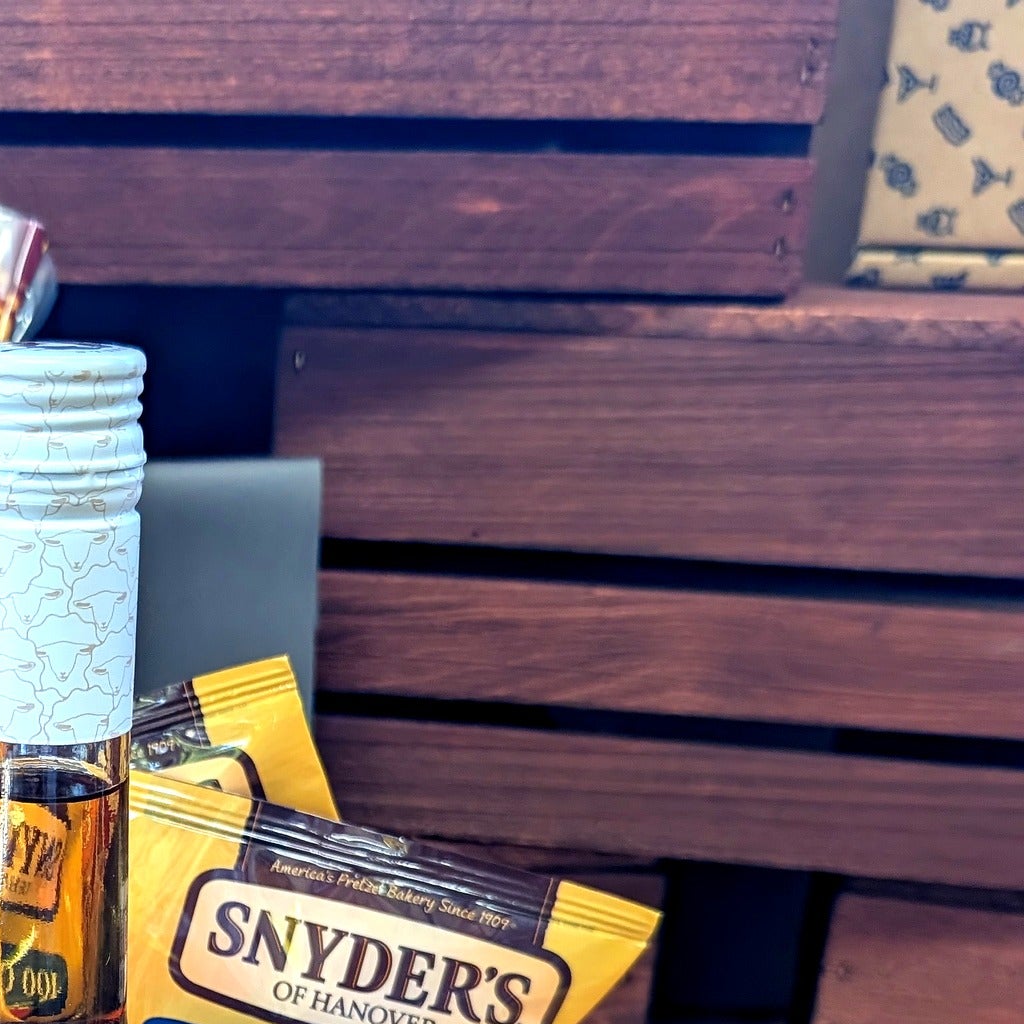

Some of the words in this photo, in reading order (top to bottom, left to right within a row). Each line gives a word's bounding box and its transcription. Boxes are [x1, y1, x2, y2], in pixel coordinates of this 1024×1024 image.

[269, 860, 334, 884] America's
[336, 872, 383, 896] Pretzel
[386, 885, 435, 914] Bakery
[438, 899, 476, 922] Since
[479, 911, 511, 931] 1909
[272, 980, 308, 1005] OF
